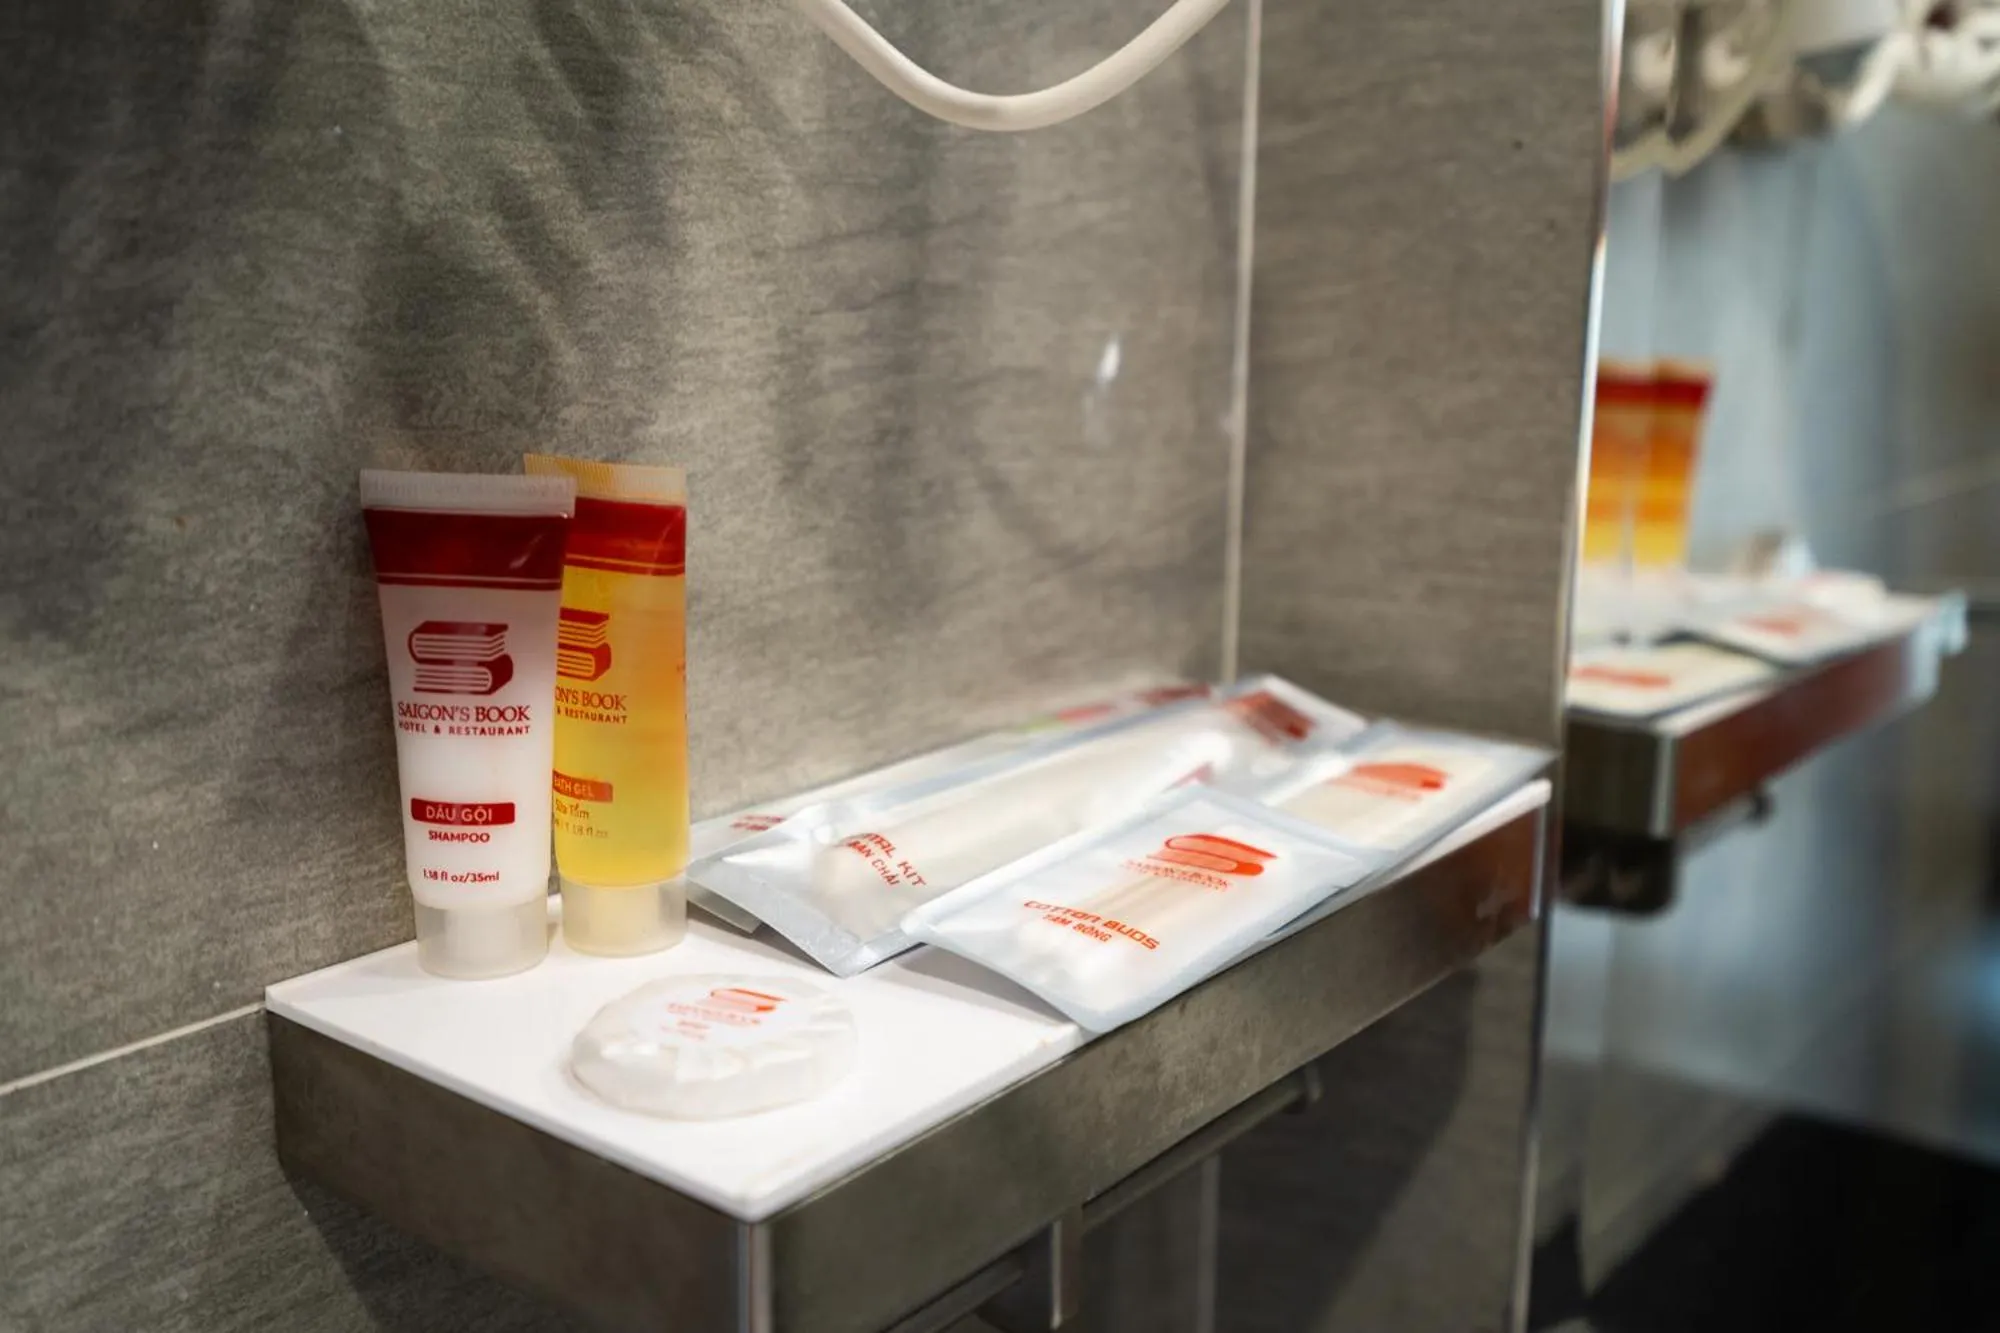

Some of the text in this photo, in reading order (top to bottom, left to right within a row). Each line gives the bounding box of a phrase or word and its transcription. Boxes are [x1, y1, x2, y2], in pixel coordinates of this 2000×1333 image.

[581, 690, 628, 712] BOOK
[397, 701, 531, 723] SAIGON'S BOOK
[564, 706, 628, 725] RESTAURANT
[448, 724, 531, 736] RESTAURANT
[460, 805, 494, 826] GỘI
[428, 830, 491, 844] SHAMPOO
[896, 861, 926, 886] KIT
[1102, 920, 1160, 950] BUDS
